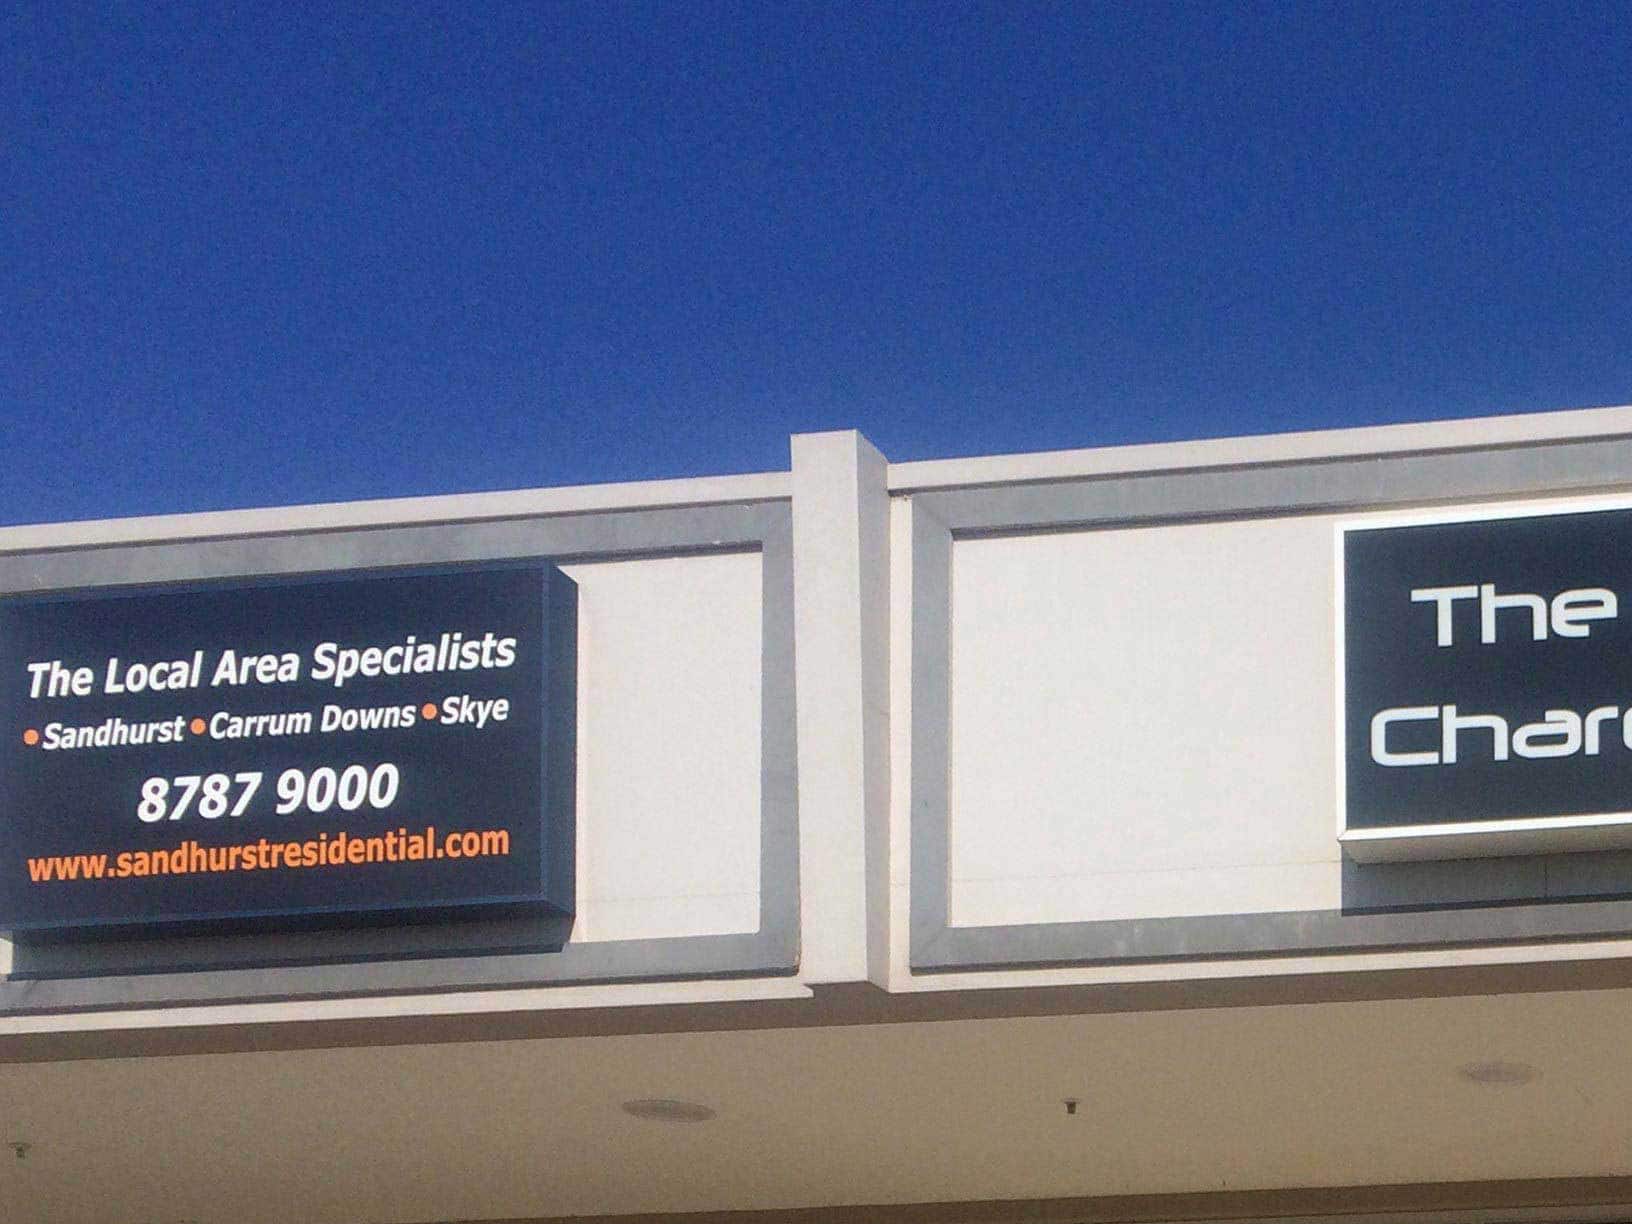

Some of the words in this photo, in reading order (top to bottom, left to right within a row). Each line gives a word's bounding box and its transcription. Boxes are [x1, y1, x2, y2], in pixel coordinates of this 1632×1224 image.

[1411, 582, 1618, 647] The
[26, 661, 93, 698] The
[103, 651, 203, 694] Local
[211, 649, 299, 686] Area
[312, 632, 516, 686] Specialists
[42, 715, 184, 750] Sandhurst
[209, 709, 311, 740] Carrum
[321, 702, 416, 732] Downs
[440, 695, 509, 727] Skye
[137, 772, 261, 823] 8787
[275, 763, 399, 814] 9000
[28, 827, 509, 882] www.sandhurstresidential.com
